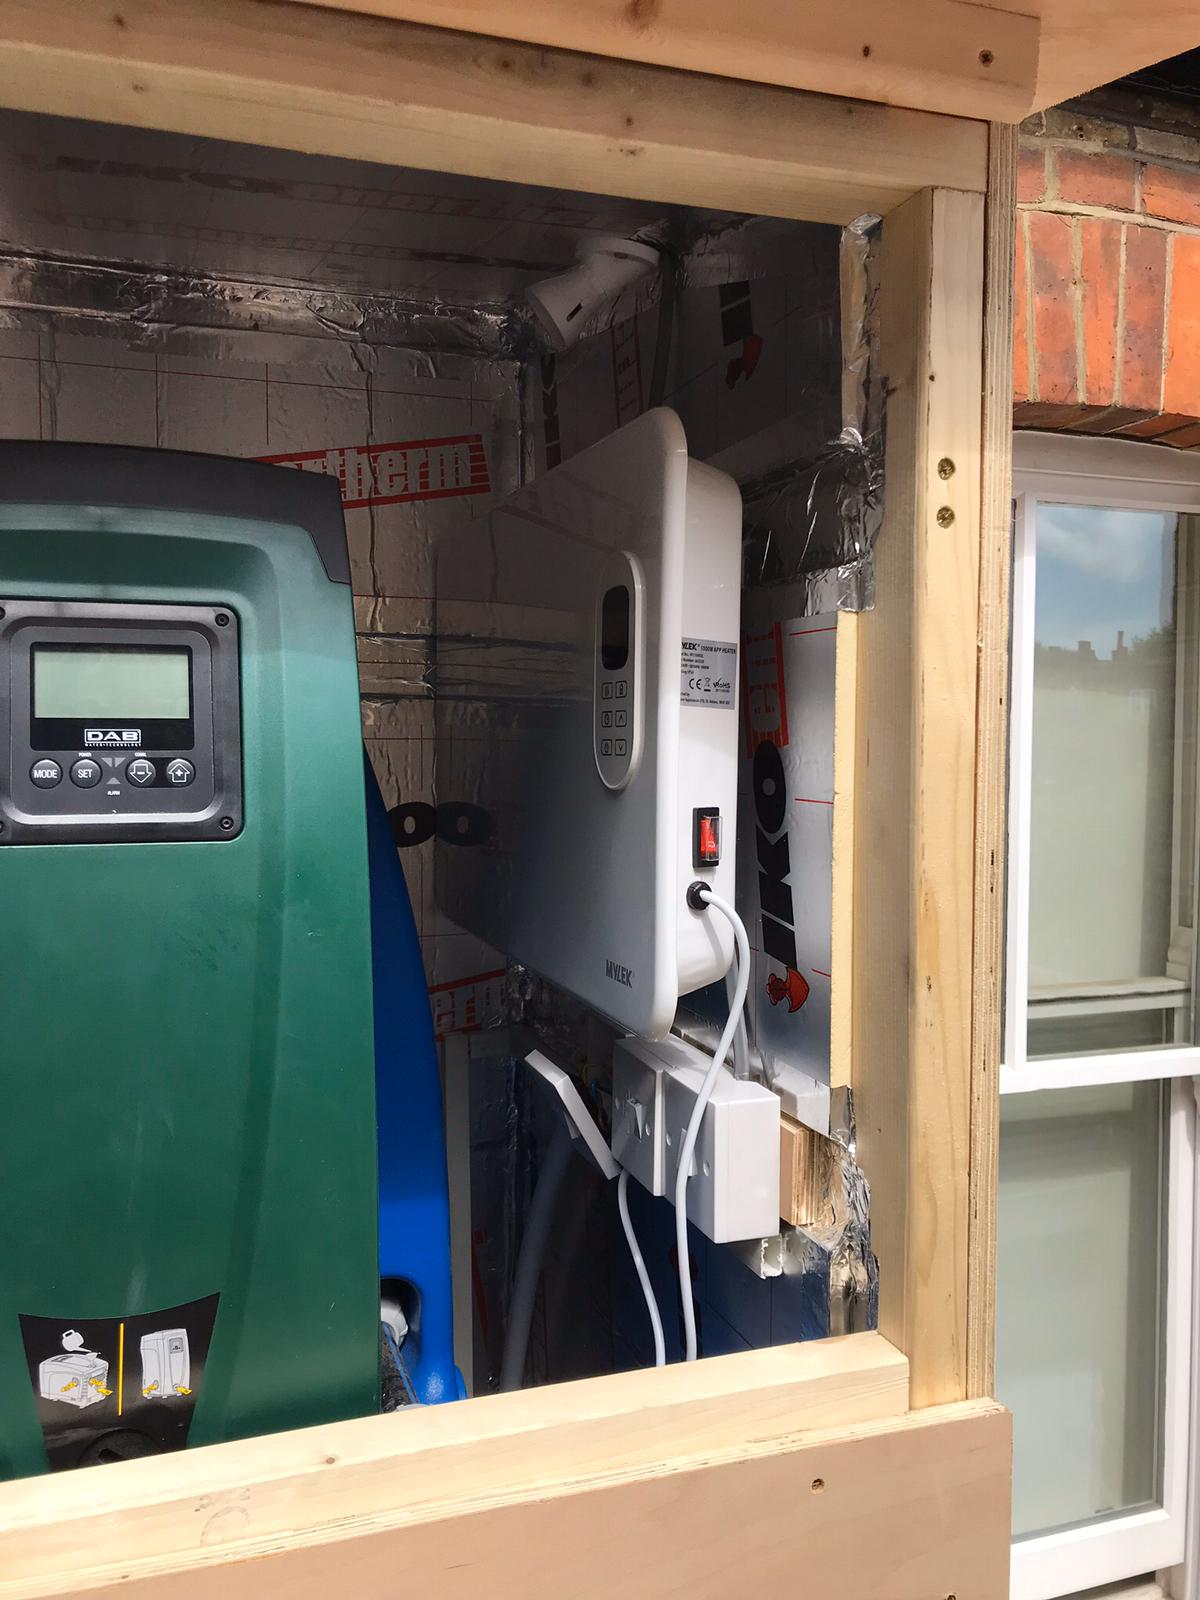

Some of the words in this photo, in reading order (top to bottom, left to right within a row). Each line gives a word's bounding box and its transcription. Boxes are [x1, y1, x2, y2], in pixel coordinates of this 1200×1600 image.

[87, 730, 140, 742] DAB
[33, 768, 58, 779] MODE
[77, 768, 93, 778] SET
[752, 739, 798, 970] IKO
[605, 959, 633, 988] MYLEK
